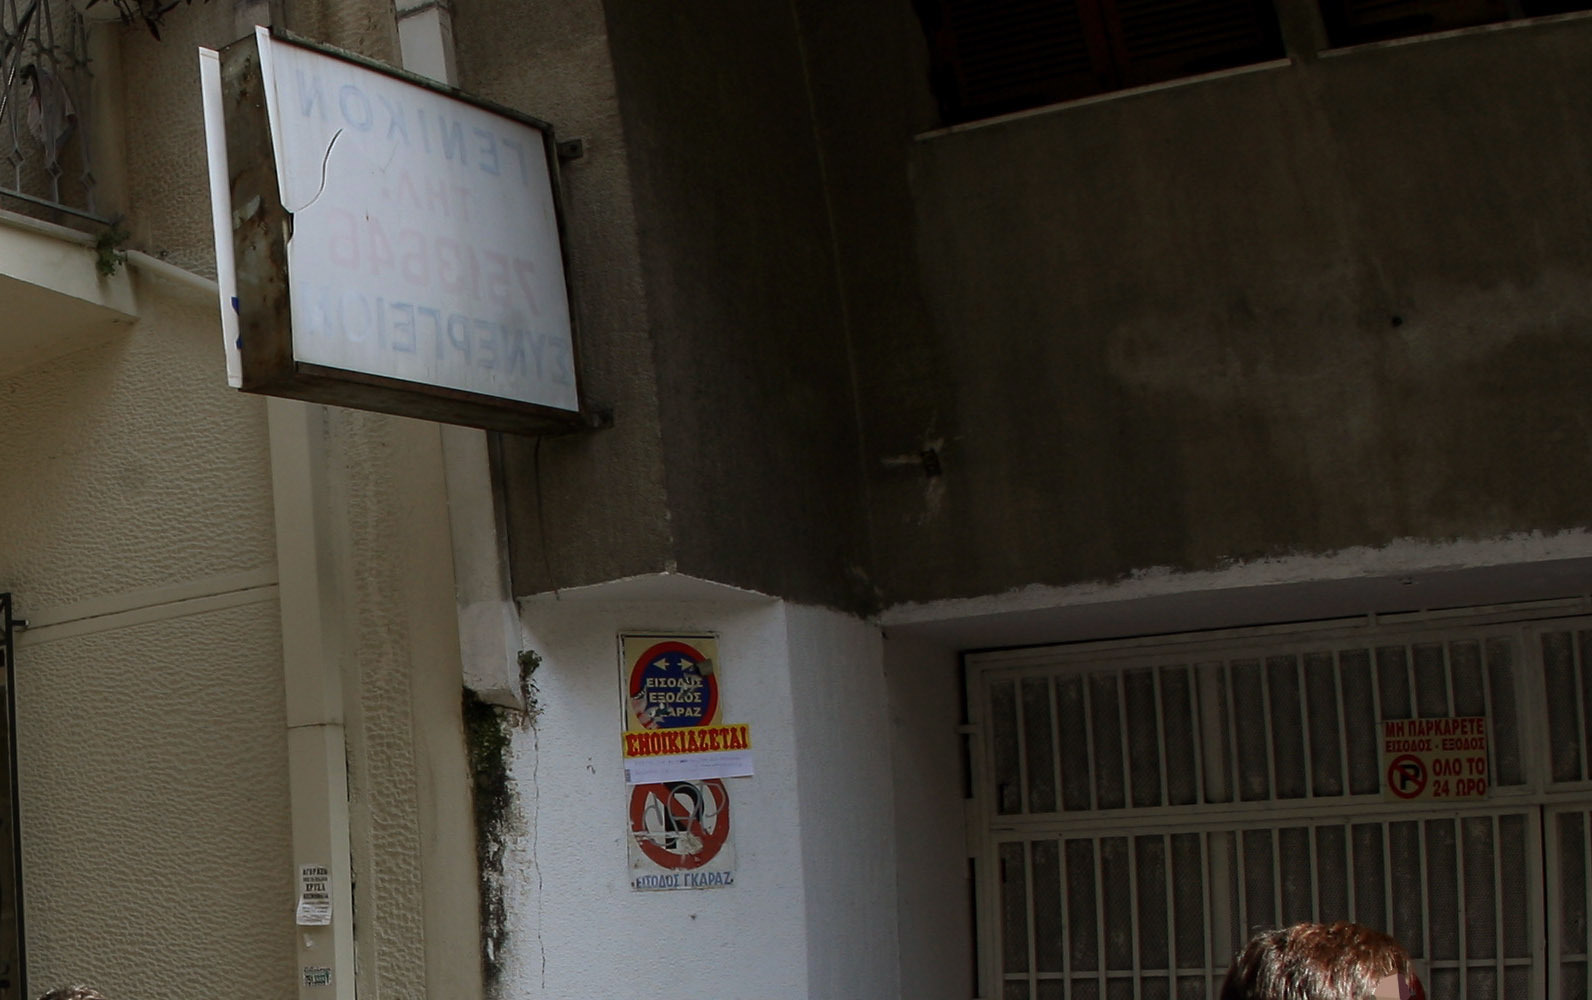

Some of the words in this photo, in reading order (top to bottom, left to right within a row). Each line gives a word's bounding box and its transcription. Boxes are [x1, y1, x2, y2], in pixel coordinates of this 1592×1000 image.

[1385, 721, 1405, 737] ΜΗ
[1408, 718, 1485, 737] ΠΑΡΚΑΡΕΤΕ
[625, 727, 748, 756] ΕΝΟΙΚΙΑΖΕΤΑΙ
[1385, 739, 1433, 753] ΕΙΣΟΔΟΣ
[1442, 737, 1485, 751] ΕΞΟΔΟΣ
[1432, 758, 1462, 776] ΟΛΟ
[1466, 757, 1485, 775] ΤΟ
[1432, 780, 1450, 798] 24
[1455, 778, 1486, 797] ΩΡΟ
[684, 871, 731, 888] ΓΚΑΡΑΖ
